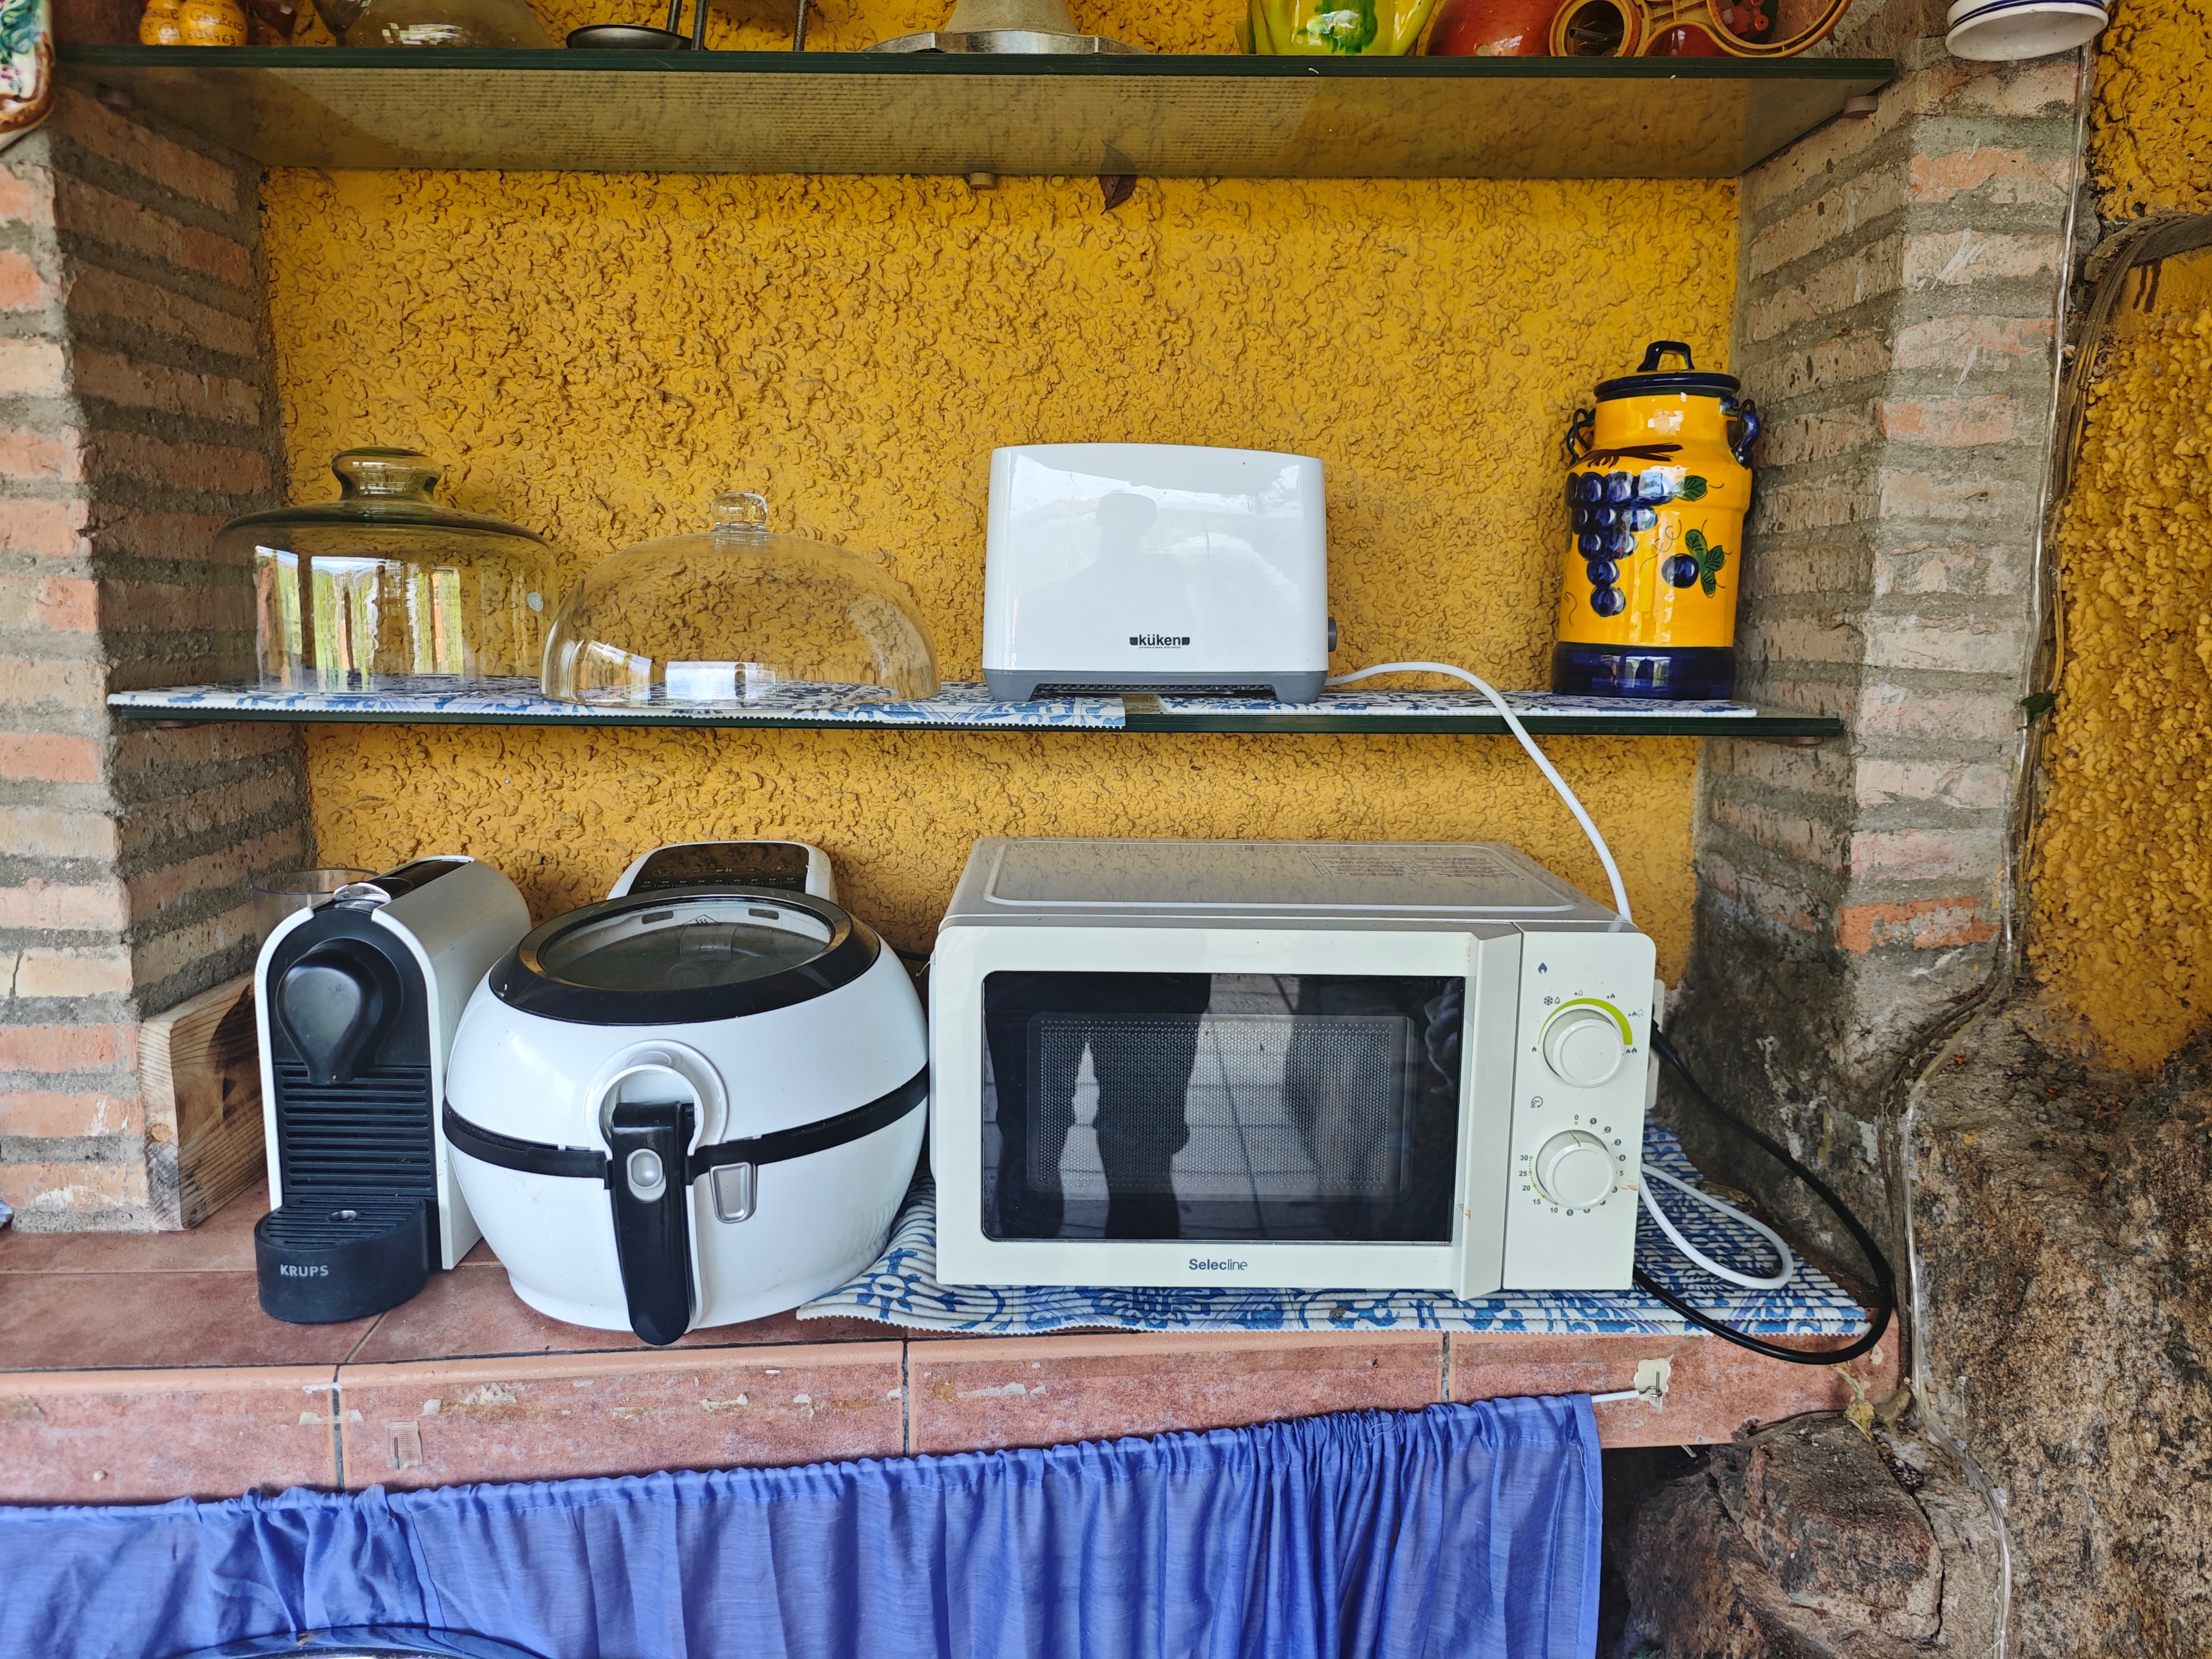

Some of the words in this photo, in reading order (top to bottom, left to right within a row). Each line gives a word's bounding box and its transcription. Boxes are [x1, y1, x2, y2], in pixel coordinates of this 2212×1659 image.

[1139, 634, 1181, 645] küken
[1189, 1258, 1248, 1270] Selecline
[280, 1264, 329, 1277] KRUPS
